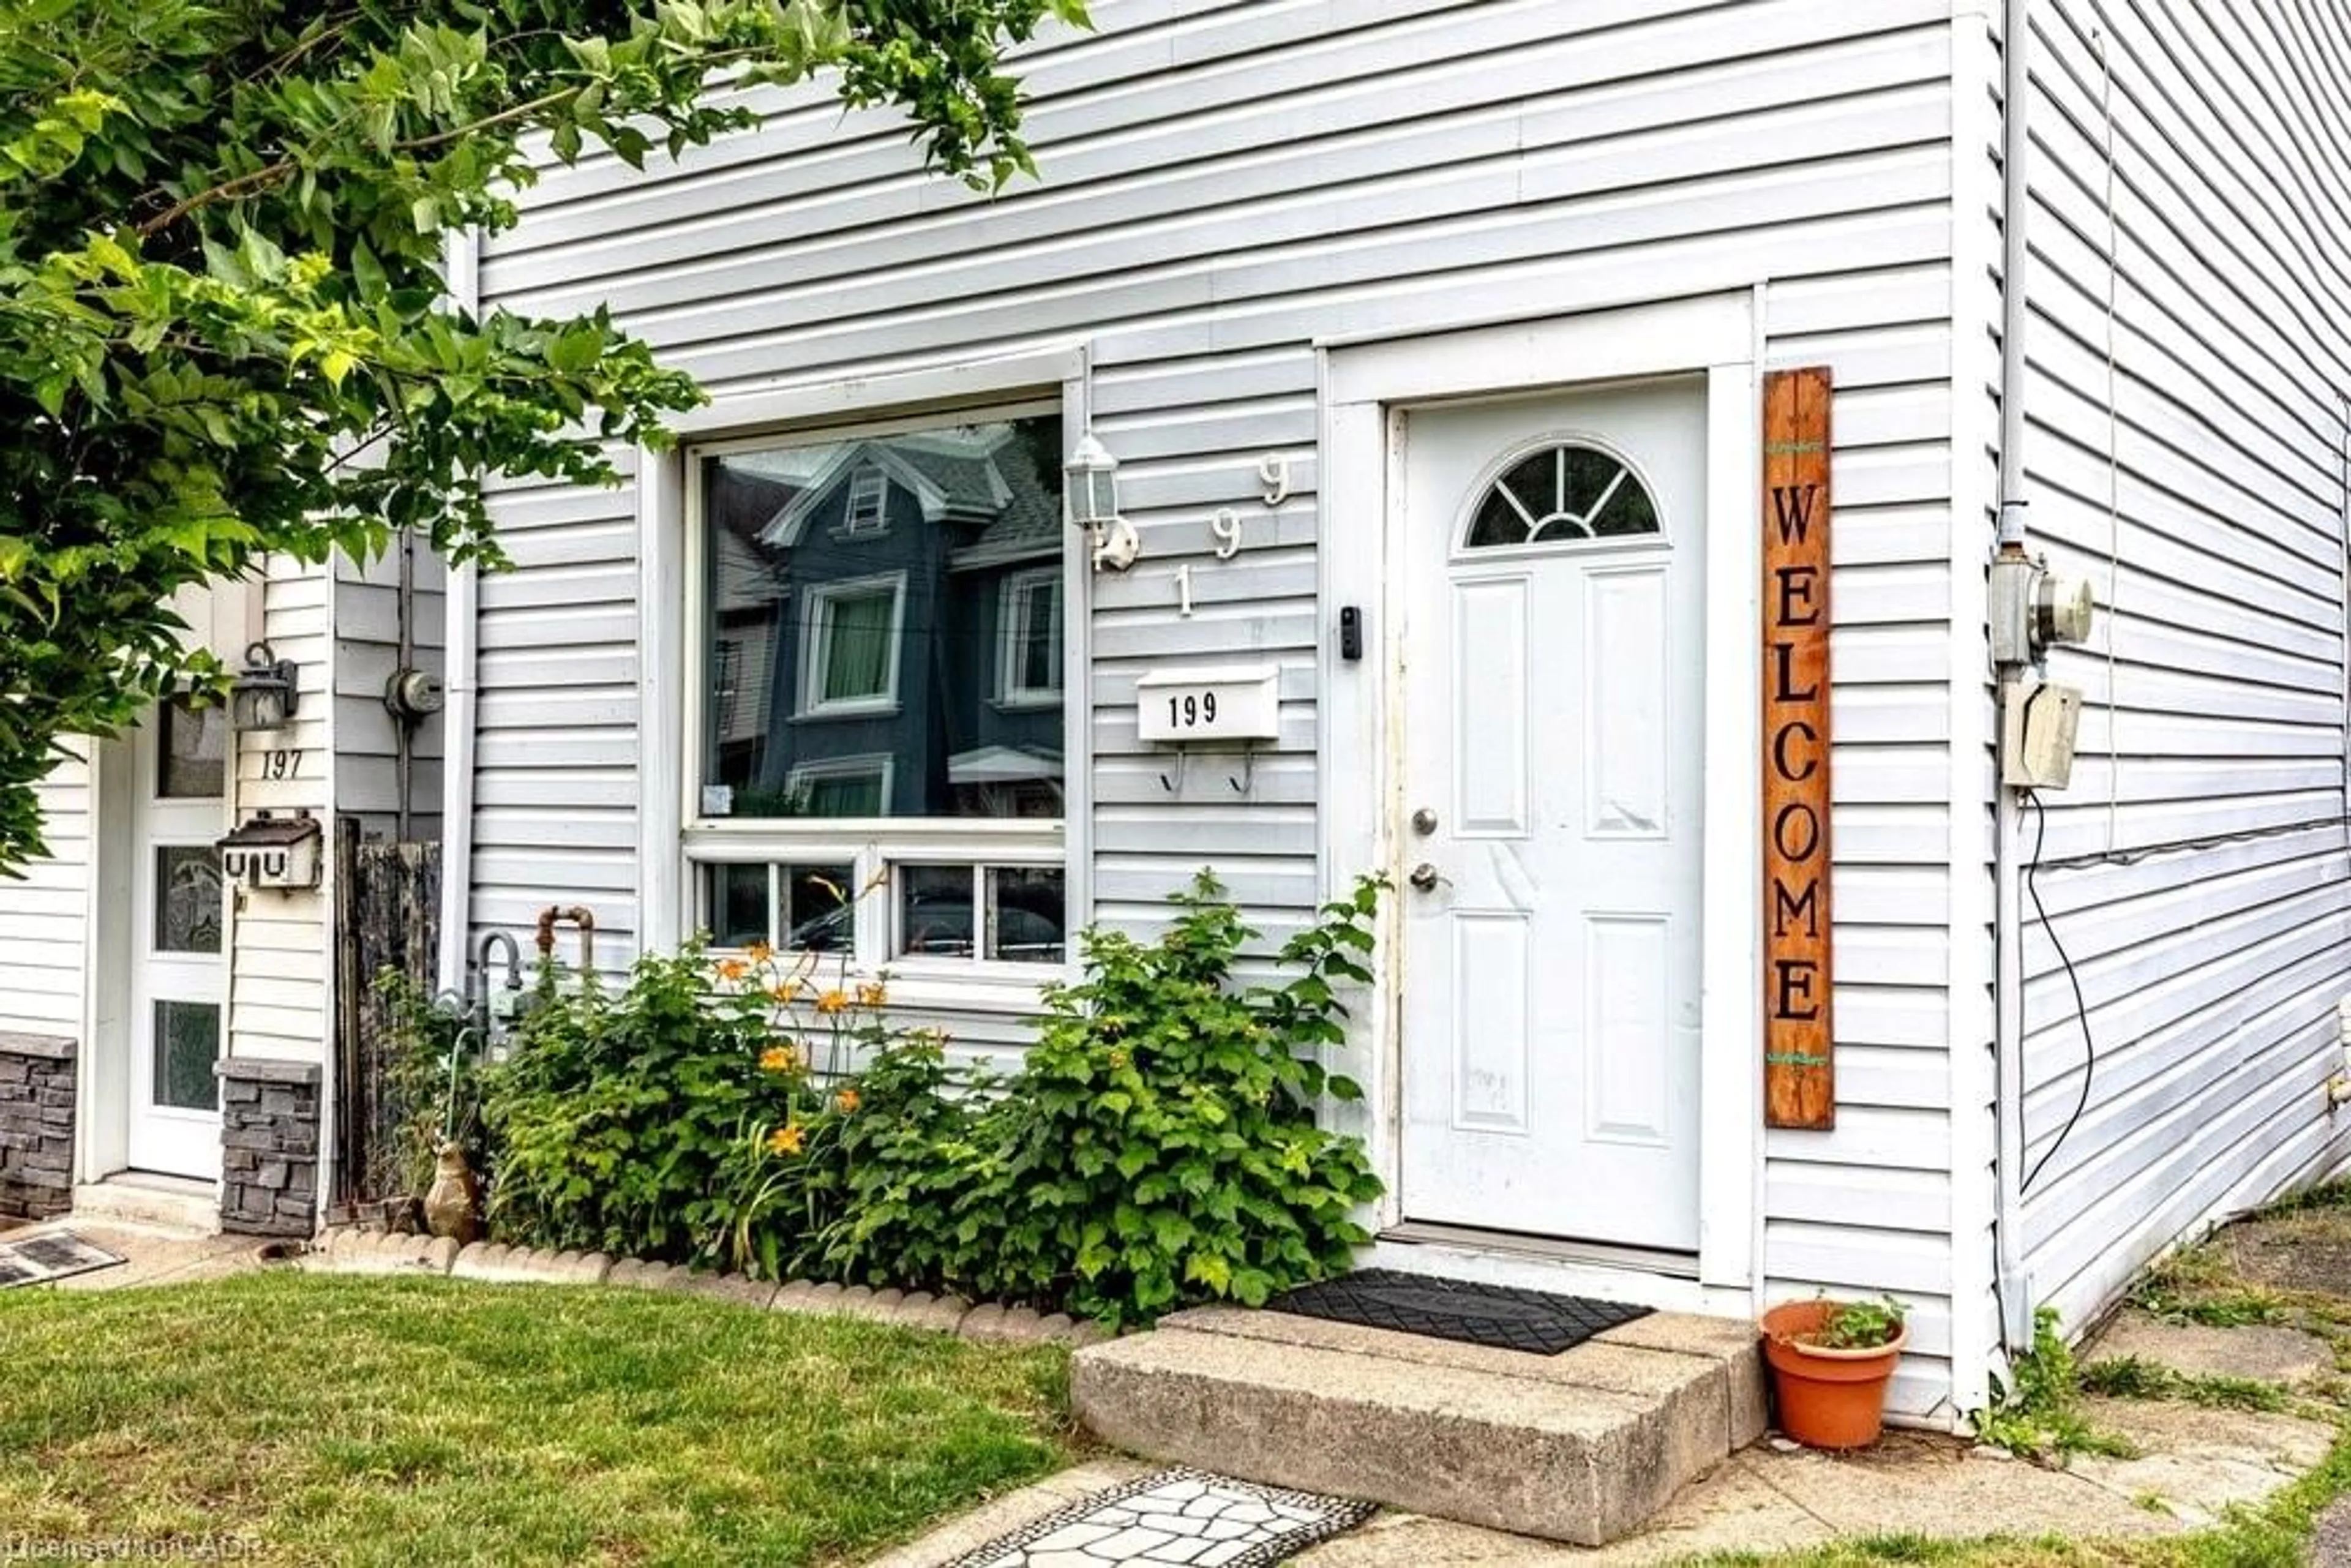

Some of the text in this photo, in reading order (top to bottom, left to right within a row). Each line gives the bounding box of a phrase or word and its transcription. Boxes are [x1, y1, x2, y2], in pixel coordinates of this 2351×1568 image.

[1169, 692, 1217, 729] 199
[261, 749, 303, 780] 197
[1772, 484, 1821, 1021] WELCOME
